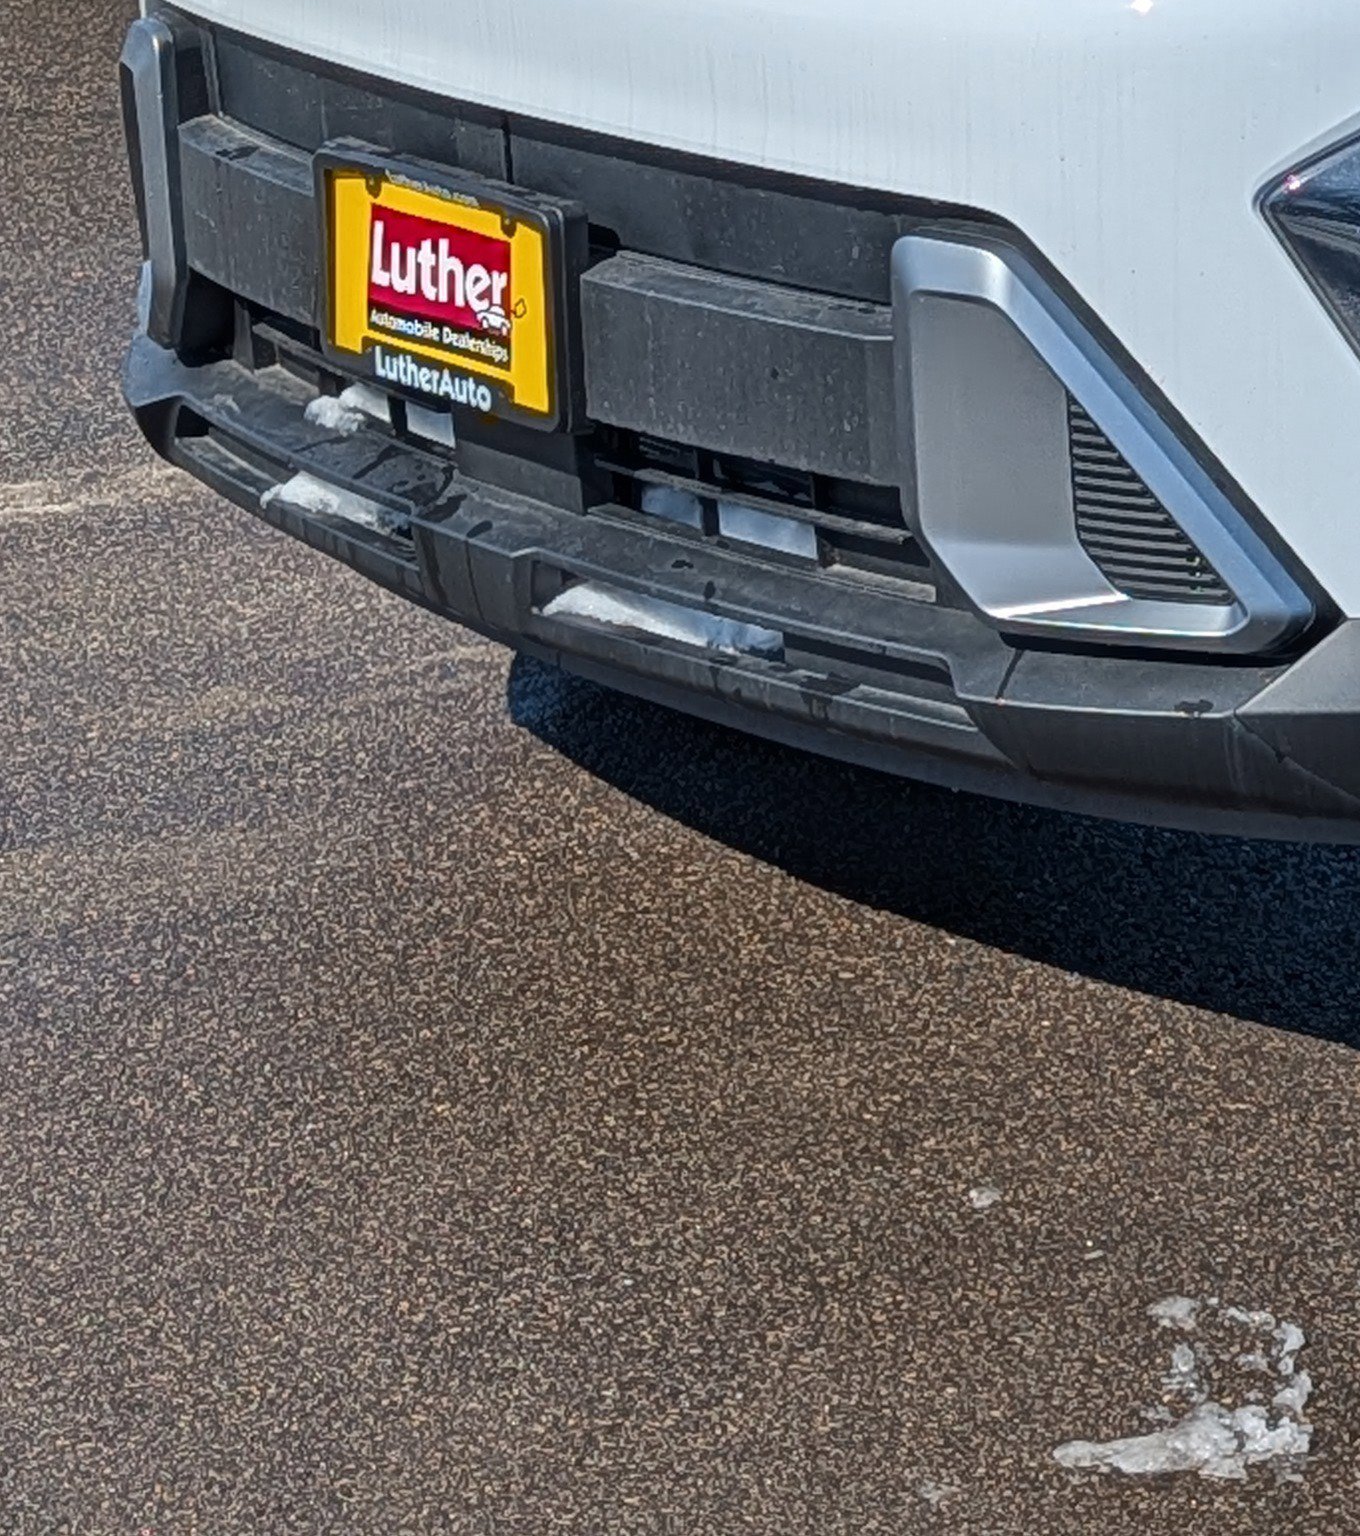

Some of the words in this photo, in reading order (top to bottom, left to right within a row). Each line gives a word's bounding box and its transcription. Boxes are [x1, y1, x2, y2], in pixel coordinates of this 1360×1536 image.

[371, 219, 509, 313] Luther
[370, 308, 440, 342] Automobile
[442, 326, 509, 363] Dealerships
[374, 345, 492, 412] LutherAuto
